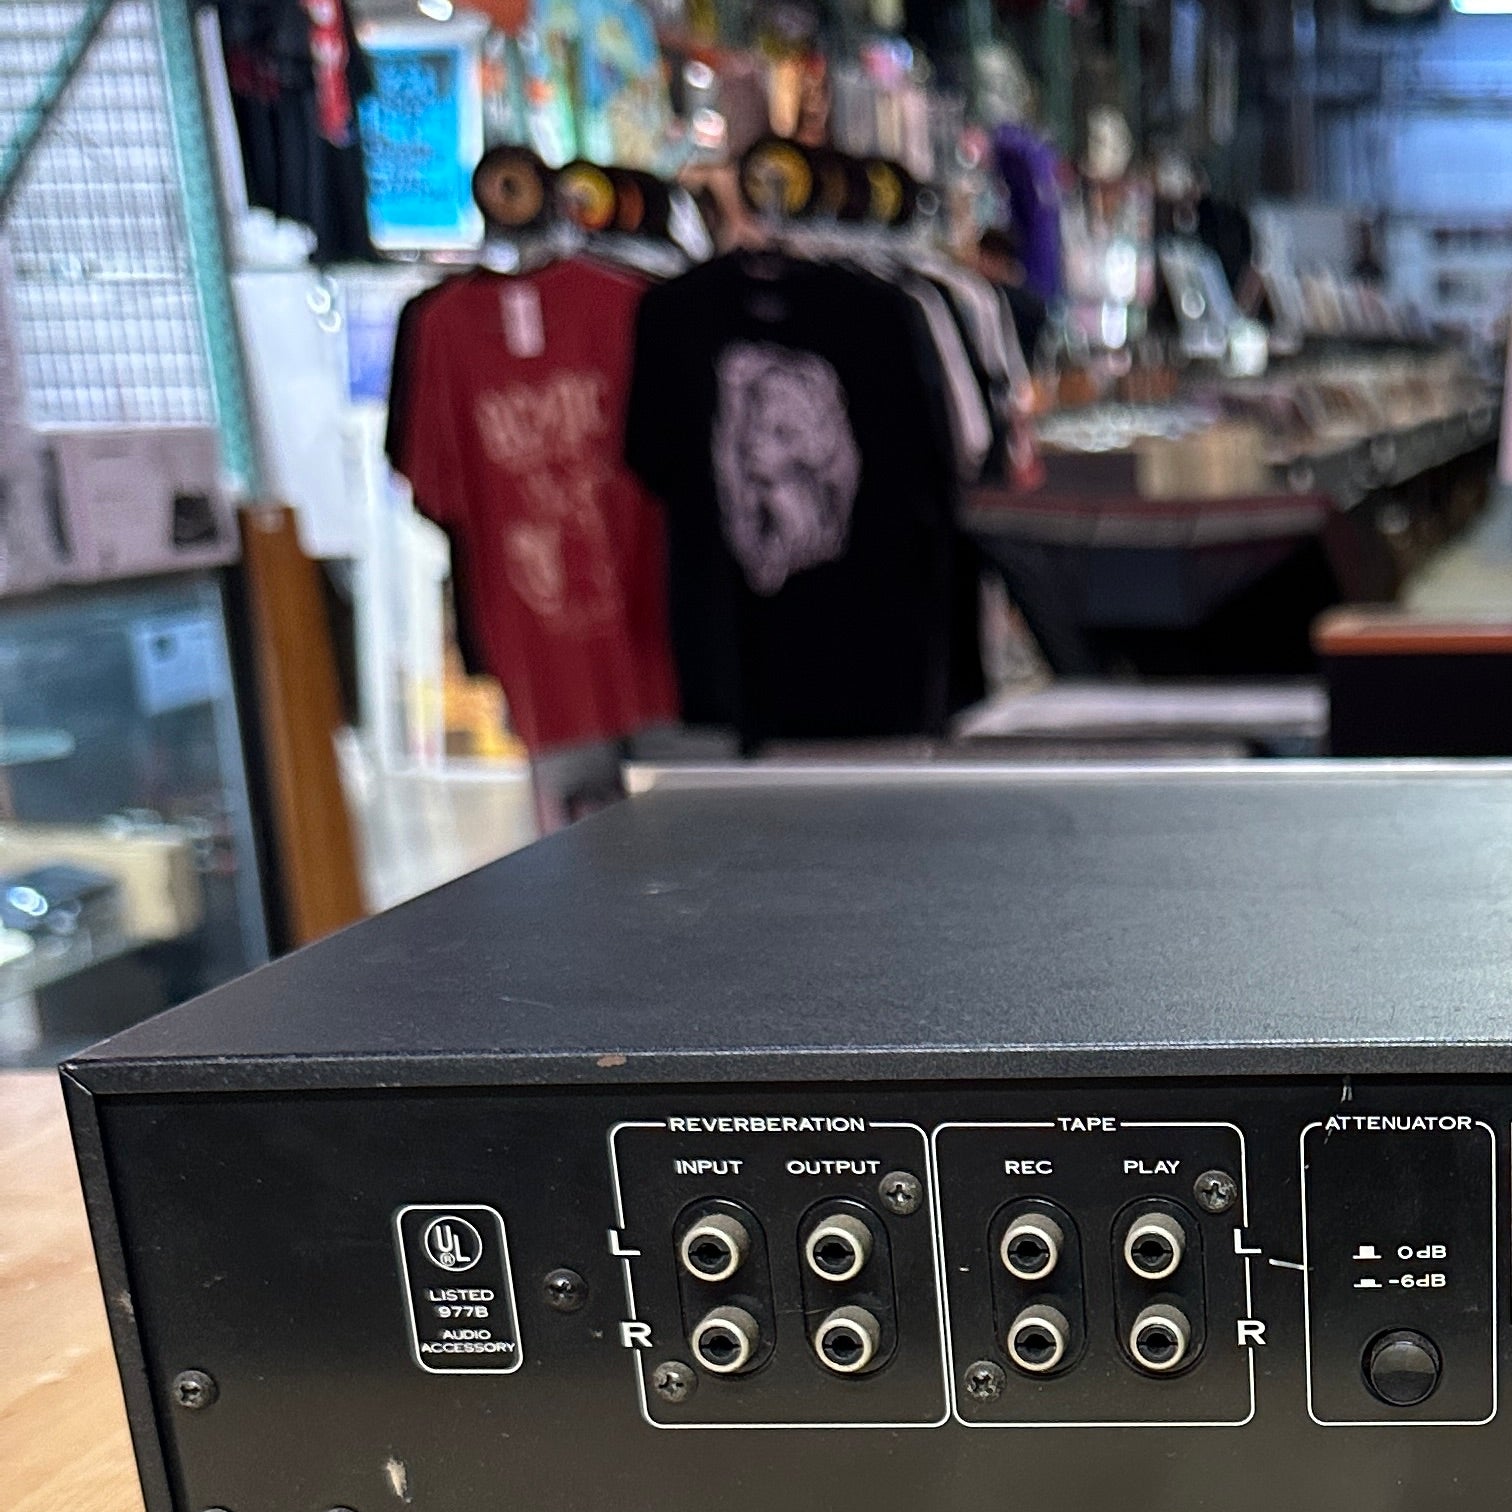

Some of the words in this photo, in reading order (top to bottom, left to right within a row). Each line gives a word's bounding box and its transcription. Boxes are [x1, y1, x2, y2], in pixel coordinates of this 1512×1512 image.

[669, 1117, 865, 1132] REVERBERATION
[1057, 1117, 1117, 1132] TAPE
[1324, 1116, 1472, 1130] ATTENUATOR
[675, 1160, 743, 1175] INPUT
[786, 1160, 880, 1175] OUTPUT
[1004, 1160, 1053, 1175] REC
[1124, 1160, 1180, 1175] PLAY
[435, 1225, 471, 1262] UL
[607, 1229, 641, 1256] L
[1233, 1228, 1262, 1255] L
[428, 1288, 495, 1302] LISTED
[438, 1306, 489, 1319] 977B
[442, 1329, 491, 1340] AUDIO
[620, 1321, 653, 1348] R
[1236, 1320, 1267, 1346] R
[420, 1342, 516, 1354] ACCESSORY
